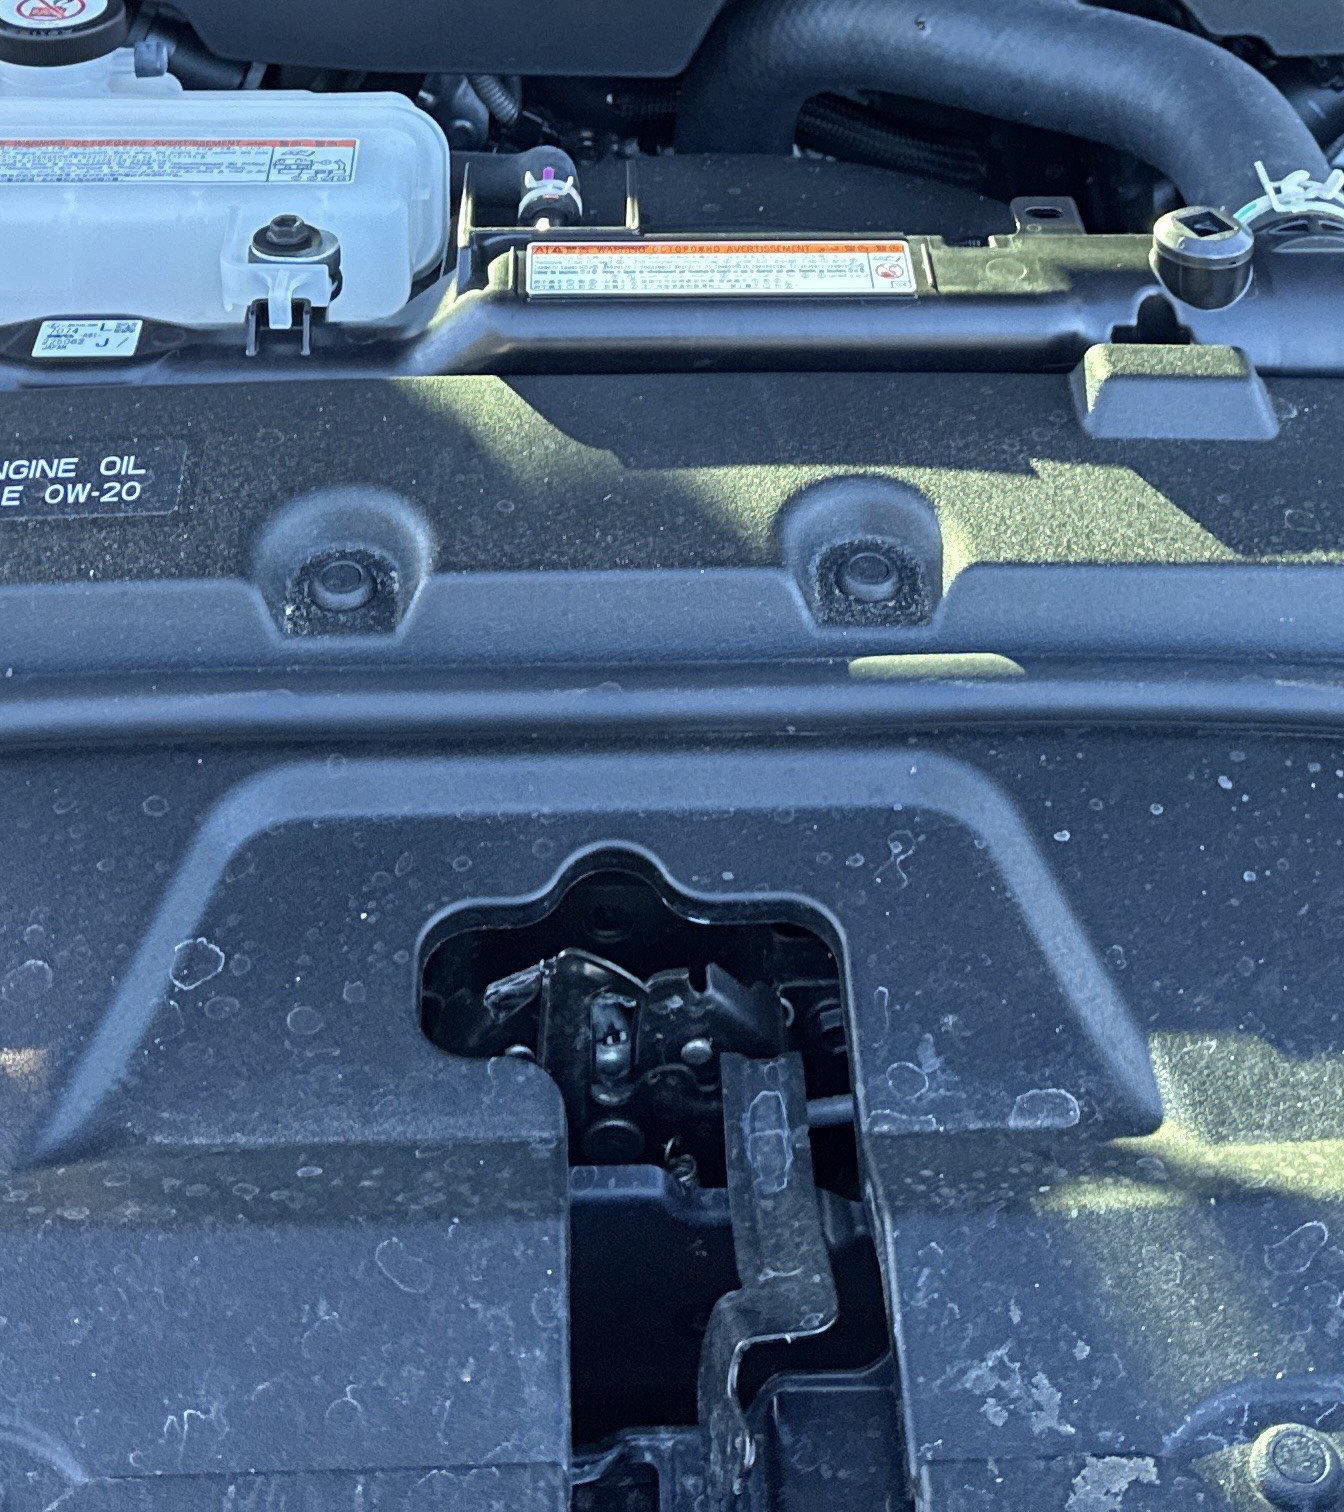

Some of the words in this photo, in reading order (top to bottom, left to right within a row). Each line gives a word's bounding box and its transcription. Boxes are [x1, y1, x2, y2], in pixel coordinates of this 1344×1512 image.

[726, 244, 810, 253] AVERTISSEMENT
[99, 455, 147, 476] OIL
[43, 481, 142, 504] 0W-20
